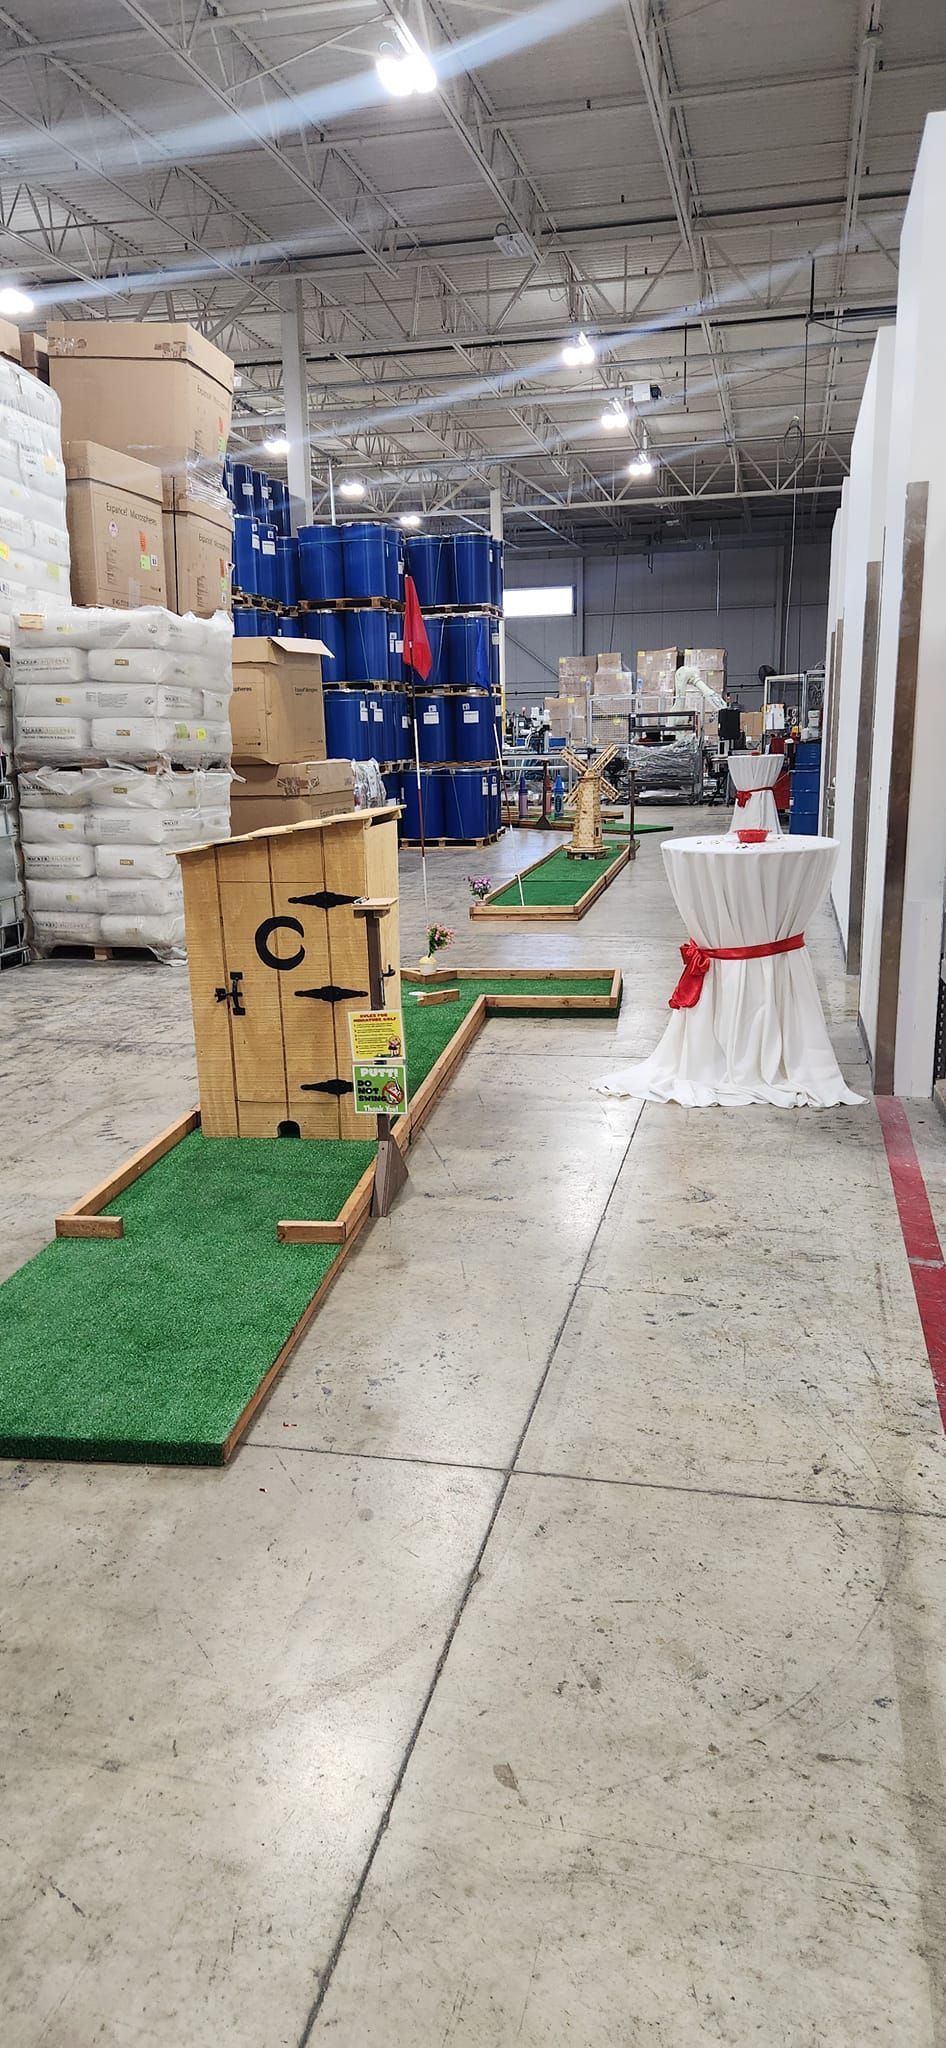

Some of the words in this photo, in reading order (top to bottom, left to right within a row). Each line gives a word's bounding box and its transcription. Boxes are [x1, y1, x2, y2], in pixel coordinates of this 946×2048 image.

[106, 501, 128, 517] Expancel
[129, 508, 158, 527] Microspheres
[360, 1067, 399, 1077] PUTT!
[363, 1104, 384, 1112] Thank
